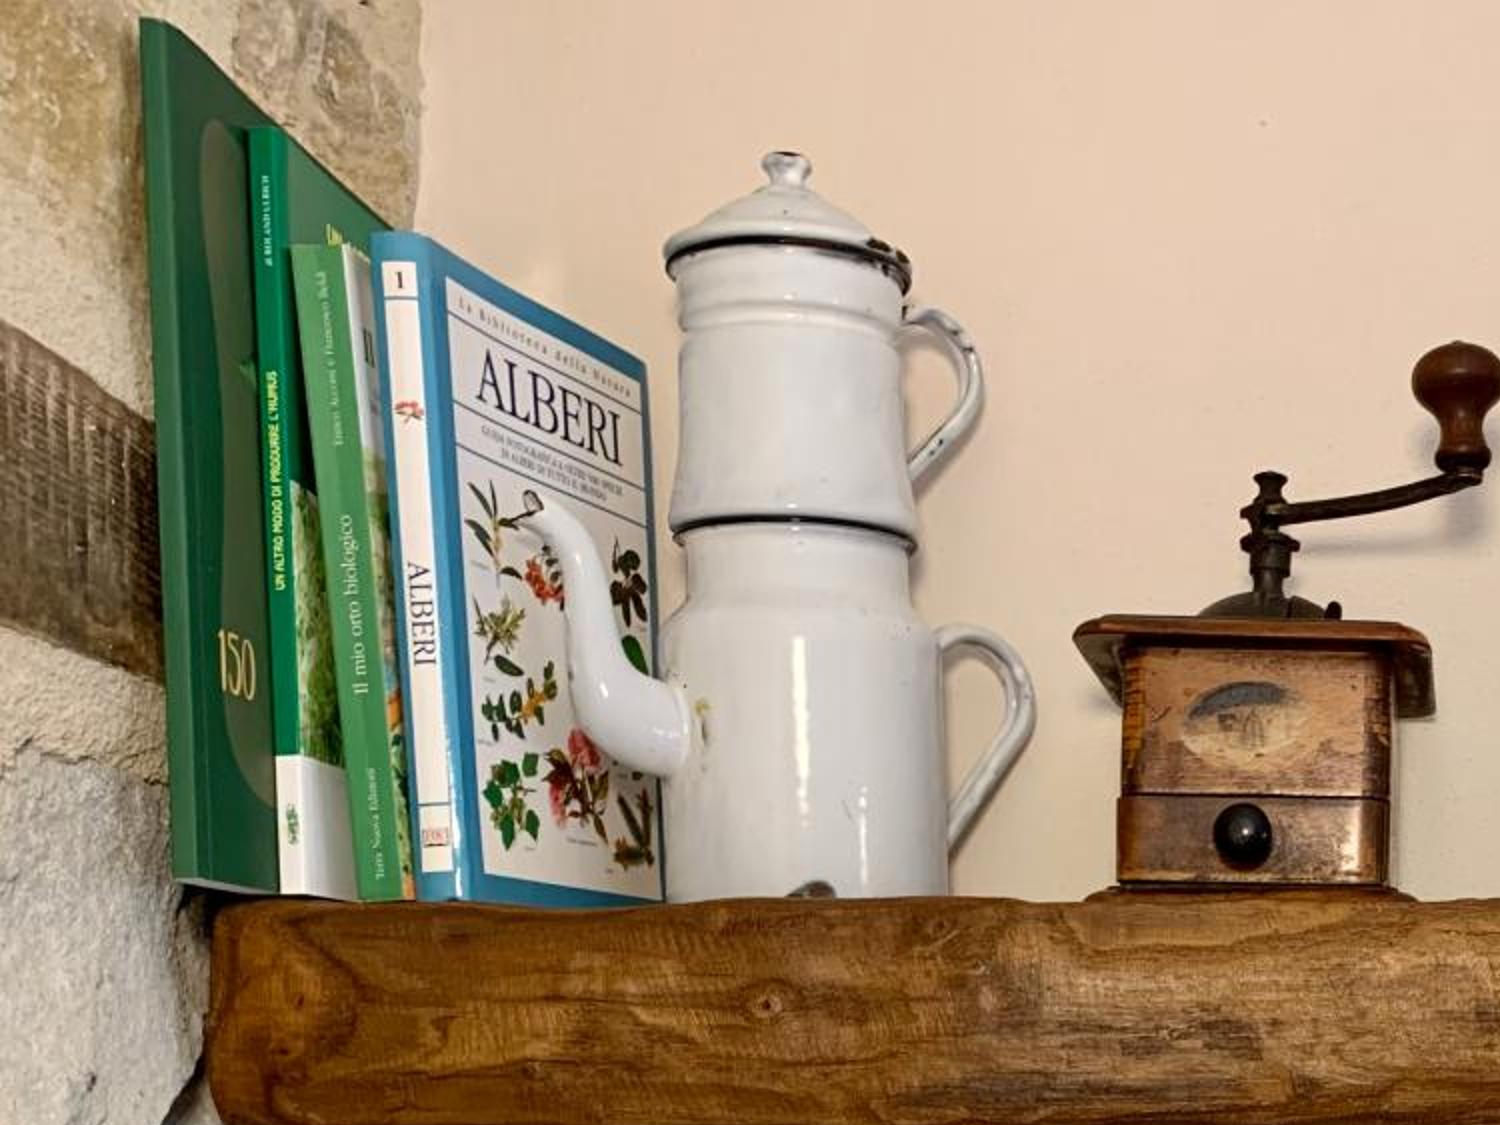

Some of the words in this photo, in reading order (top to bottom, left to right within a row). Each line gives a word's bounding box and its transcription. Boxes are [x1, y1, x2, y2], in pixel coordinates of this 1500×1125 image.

[395, 271, 404, 289] 1
[479, 307, 548, 355] Biblioteca
[555, 350, 587, 374] della
[265, 370, 279, 419] L'HUMUS
[476, 348, 623, 467] ALBERI
[267, 423, 282, 482] PRODURRE
[271, 485, 283, 497] DI
[271, 498, 284, 533] MODO
[272, 534, 285, 571] ALTRO
[339, 514, 359, 596] biologico
[274, 573, 287, 591] UN
[348, 601, 364, 637] orto
[408, 562, 437, 667] ALBERI
[217, 628, 257, 701] 150
[353, 642, 368, 676] mio
[351, 682, 369, 694] Il
